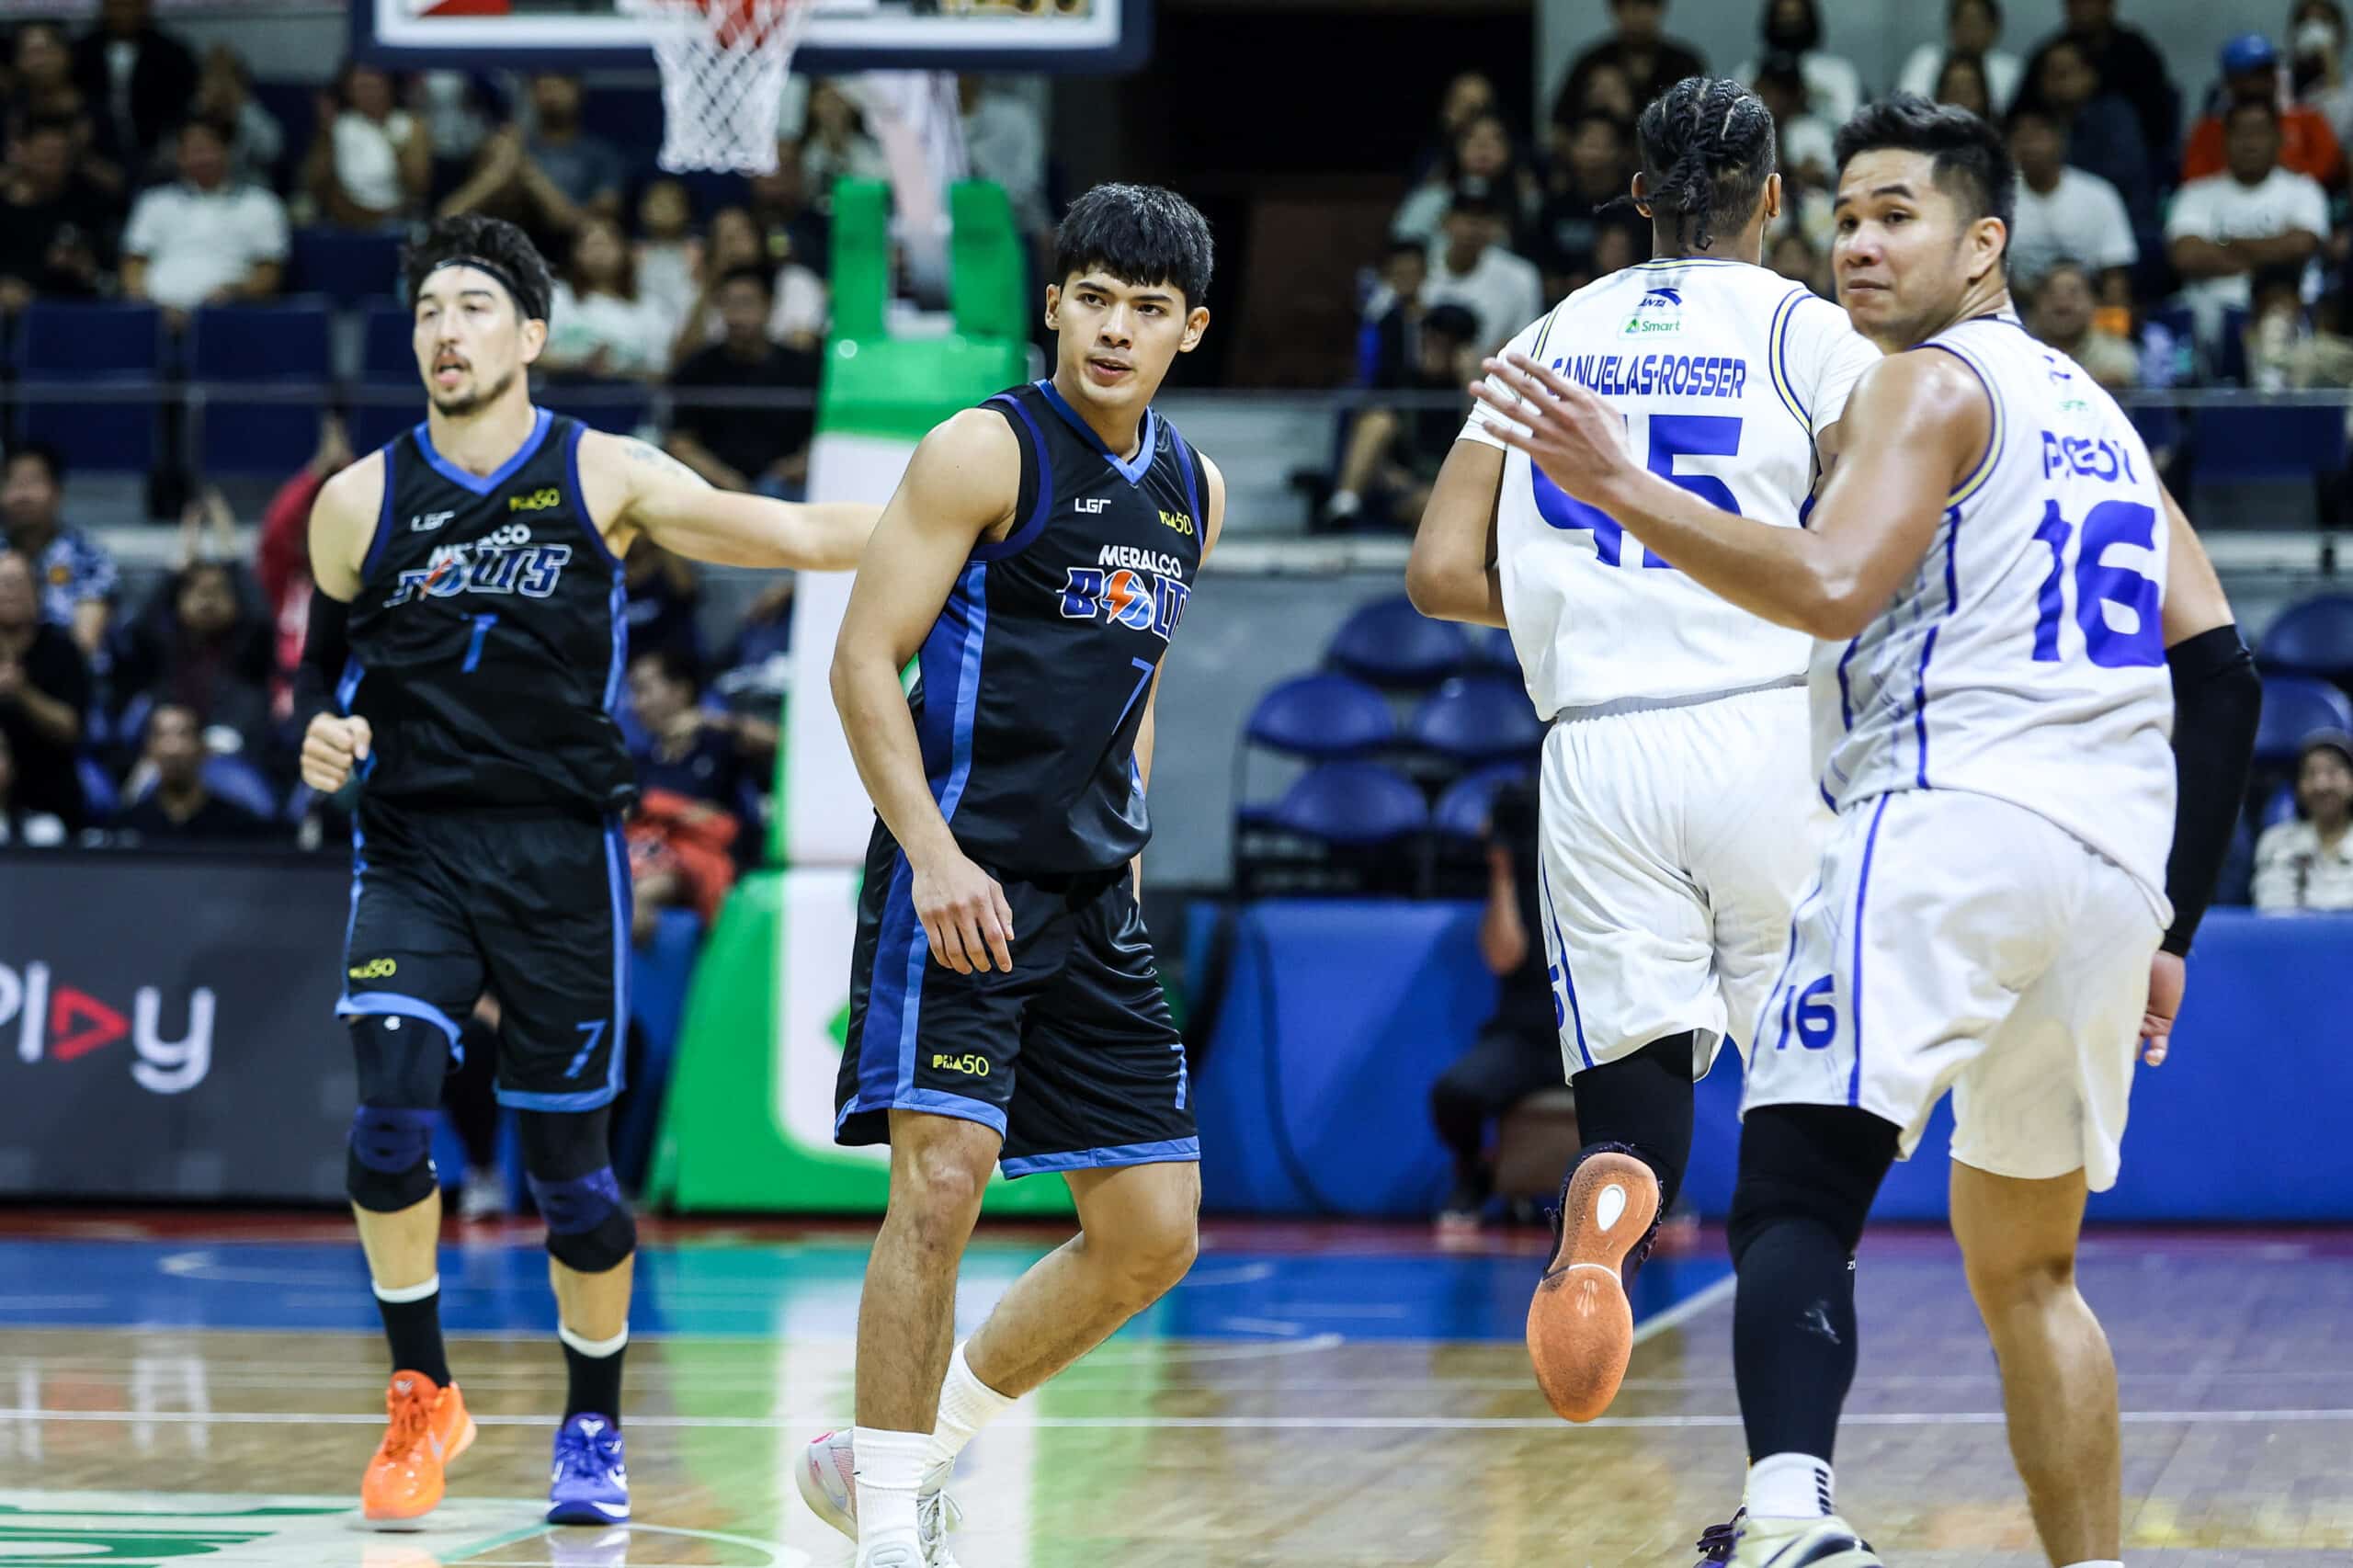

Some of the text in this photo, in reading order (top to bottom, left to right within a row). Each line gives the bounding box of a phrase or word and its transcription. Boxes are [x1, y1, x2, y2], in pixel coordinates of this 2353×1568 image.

[1642, 320, 1680, 332] Smart
[1098, 545, 1183, 579] MERALCO
[2031, 498, 2167, 669] 16
[1056, 567, 1191, 642] BOLT
[461, 612, 500, 674] 7
[1111, 656, 1155, 736] 7
[1776, 973, 1836, 1051] 16
[563, 1019, 608, 1078] 7
